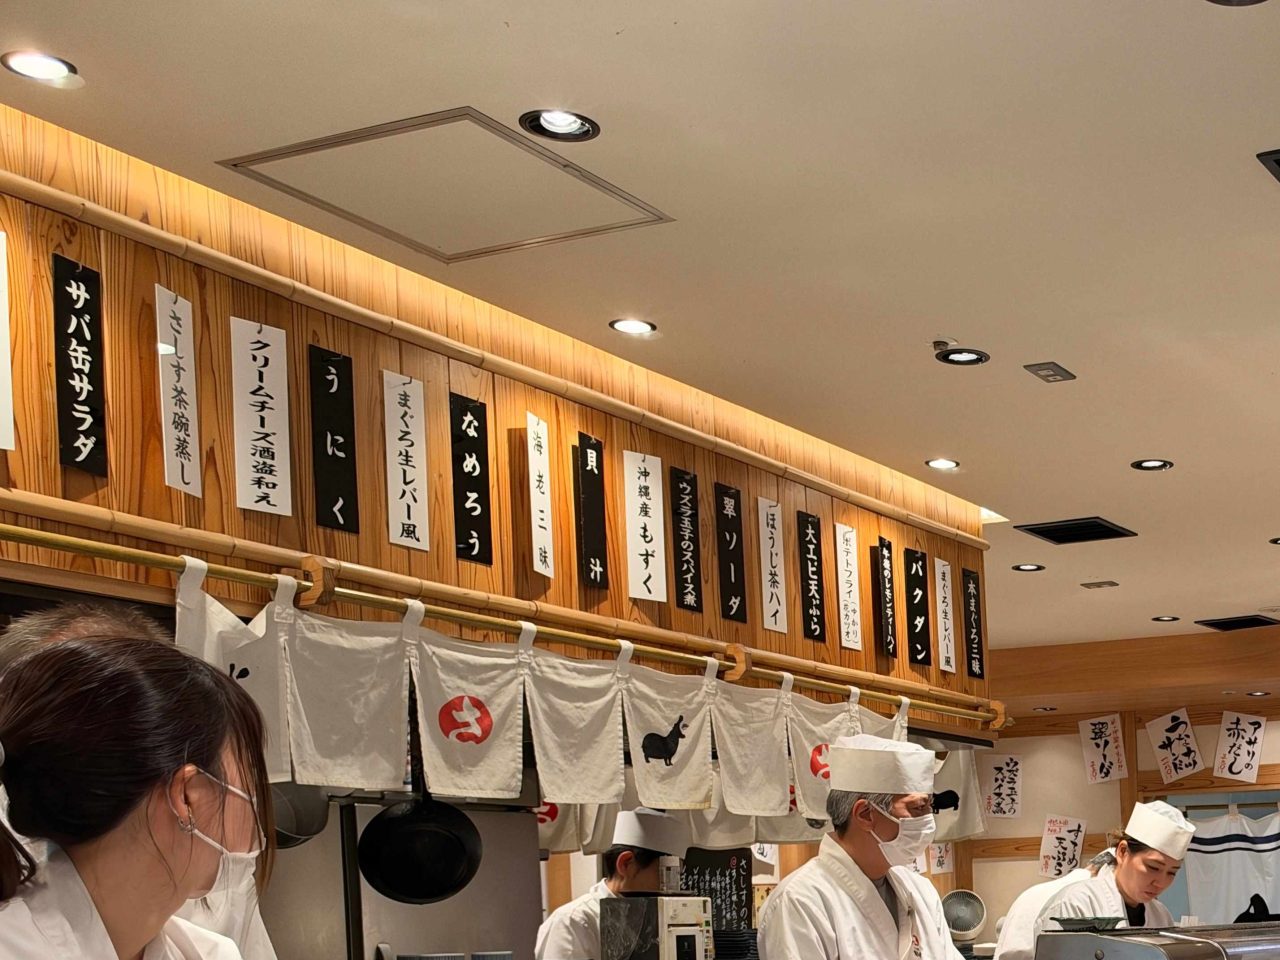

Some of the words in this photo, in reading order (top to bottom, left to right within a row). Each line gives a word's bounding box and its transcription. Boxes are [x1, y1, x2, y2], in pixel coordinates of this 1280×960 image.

[66, 280, 96, 463] サバ缶サラダ
[168, 309, 191, 486] さしす茶碗蒸し
[248, 339, 279, 508] クリームチーズ酒盗和え
[325, 366, 346, 525] うにく
[397, 391, 420, 543] まぐろ生レバー風
[461, 412, 481, 556] なめろう
[586, 449, 604, 583] 貝汁
[637, 466, 656, 595] 沖縄産もずく
[678, 481, 697, 608] ウズラ玉子のスパイス煮
[723, 496, 741, 616] 翠ソーダ
[765, 511, 781, 626] ほうじ茶ハイ
[804, 523, 821, 636] 大エビ天ぷら
[940, 571, 953, 669] まぐろ生レバー風
[1225, 716, 1248, 775] 赤だし
